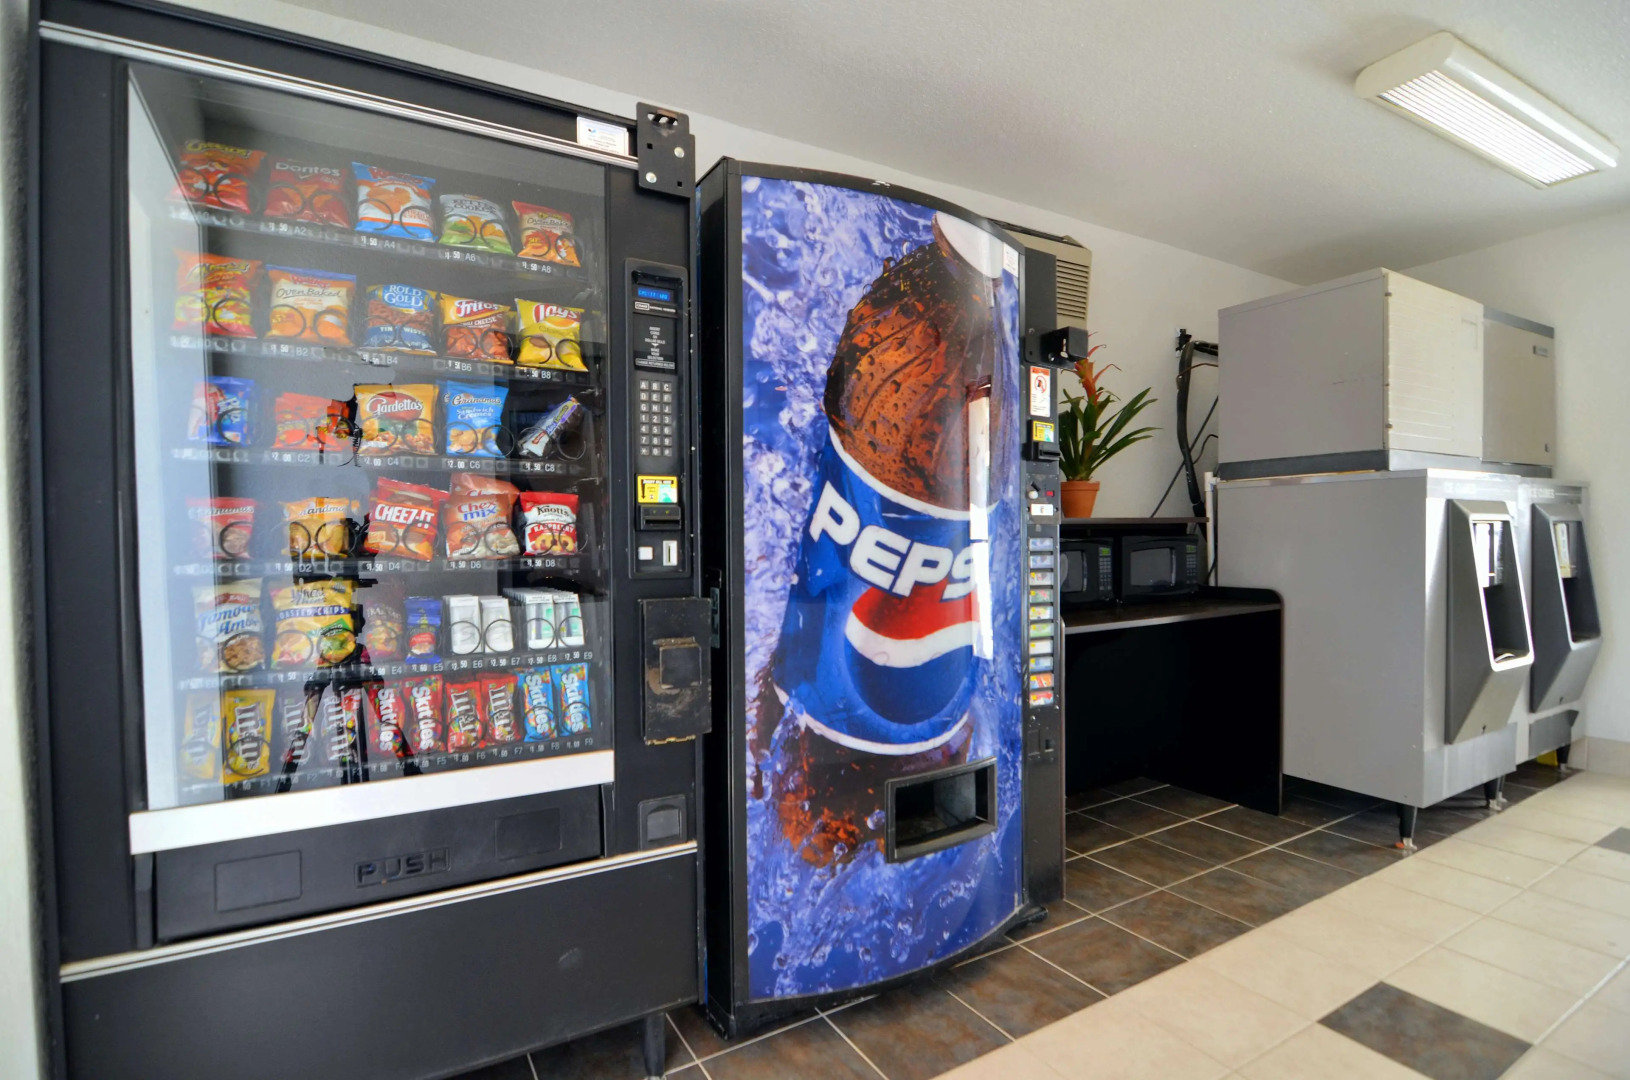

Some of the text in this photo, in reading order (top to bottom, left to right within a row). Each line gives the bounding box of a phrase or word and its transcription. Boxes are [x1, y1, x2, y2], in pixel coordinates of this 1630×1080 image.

[275, 161, 341, 177] Doritos
[294, 226, 307, 236] A2
[384, 240, 396, 249] A4
[465, 252, 477, 262] A6
[541, 264, 552, 274] A8
[275, 287, 342, 299] Oven Baked
[389, 284, 422, 296] ROLD
[384, 292, 423, 307] GOLD
[454, 299, 499, 317] Fritos
[296, 346, 308, 357] B2
[461, 363, 472, 372] B6
[541, 370, 551, 379] B8
[366, 397, 424, 415] Gardetto's
[297, 453, 311, 463] C2
[387, 457, 400, 466] C4
[469, 460, 480, 469] C6
[544, 463, 555, 472] C8
[457, 501, 497, 514] Chex
[809, 480, 980, 600] PEPS
[299, 563, 312, 573] D2
[388, 562, 401, 571] D4
[470, 560, 481, 569] D6
[545, 560, 556, 568] D8
[317, 606, 346, 616] CHIPS
[547, 655, 557, 663] E8
[583, 651, 593, 660] E9
[472, 660, 483, 669] E6
[511, 657, 521, 666] E7
[391, 666, 402, 675] E4
[433, 663, 444, 672] E5
[525, 673, 550, 734] Skittles
[561, 672, 587, 733] Skittles
[377, 687, 398, 751] Skittles
[411, 686, 437, 750] Skittles
[514, 746, 523, 755] F7
[436, 756, 447, 766] F5
[476, 752, 486, 761] F6
[358, 848, 449, 883] PUSH
